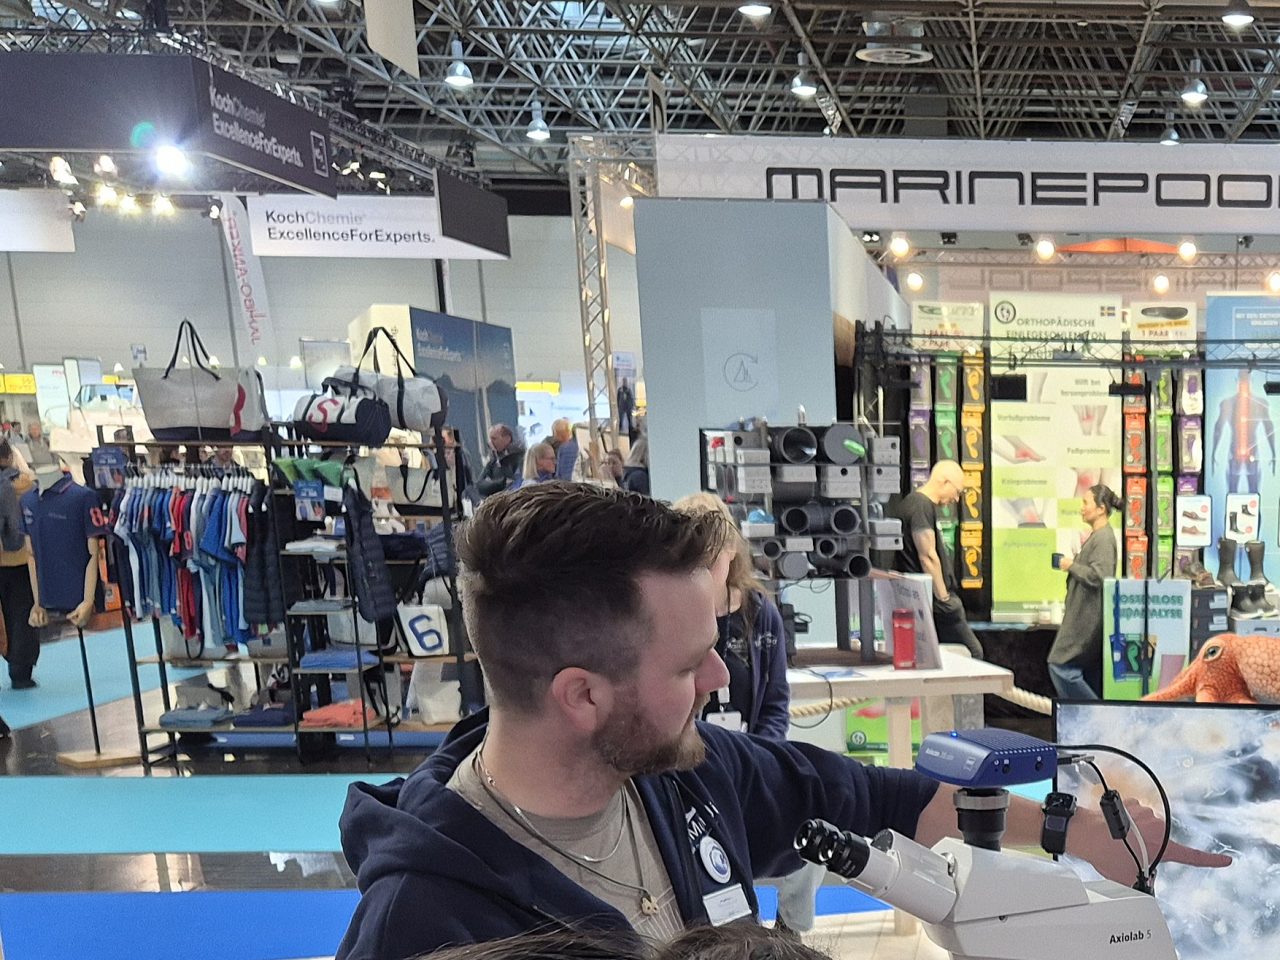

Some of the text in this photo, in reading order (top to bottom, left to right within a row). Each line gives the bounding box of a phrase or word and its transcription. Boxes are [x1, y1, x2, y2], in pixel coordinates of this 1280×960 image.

[1016, 316, 1096, 327] ORTHOPÄDISCHE
[1109, 929, 1152, 944] Axiolab 5
